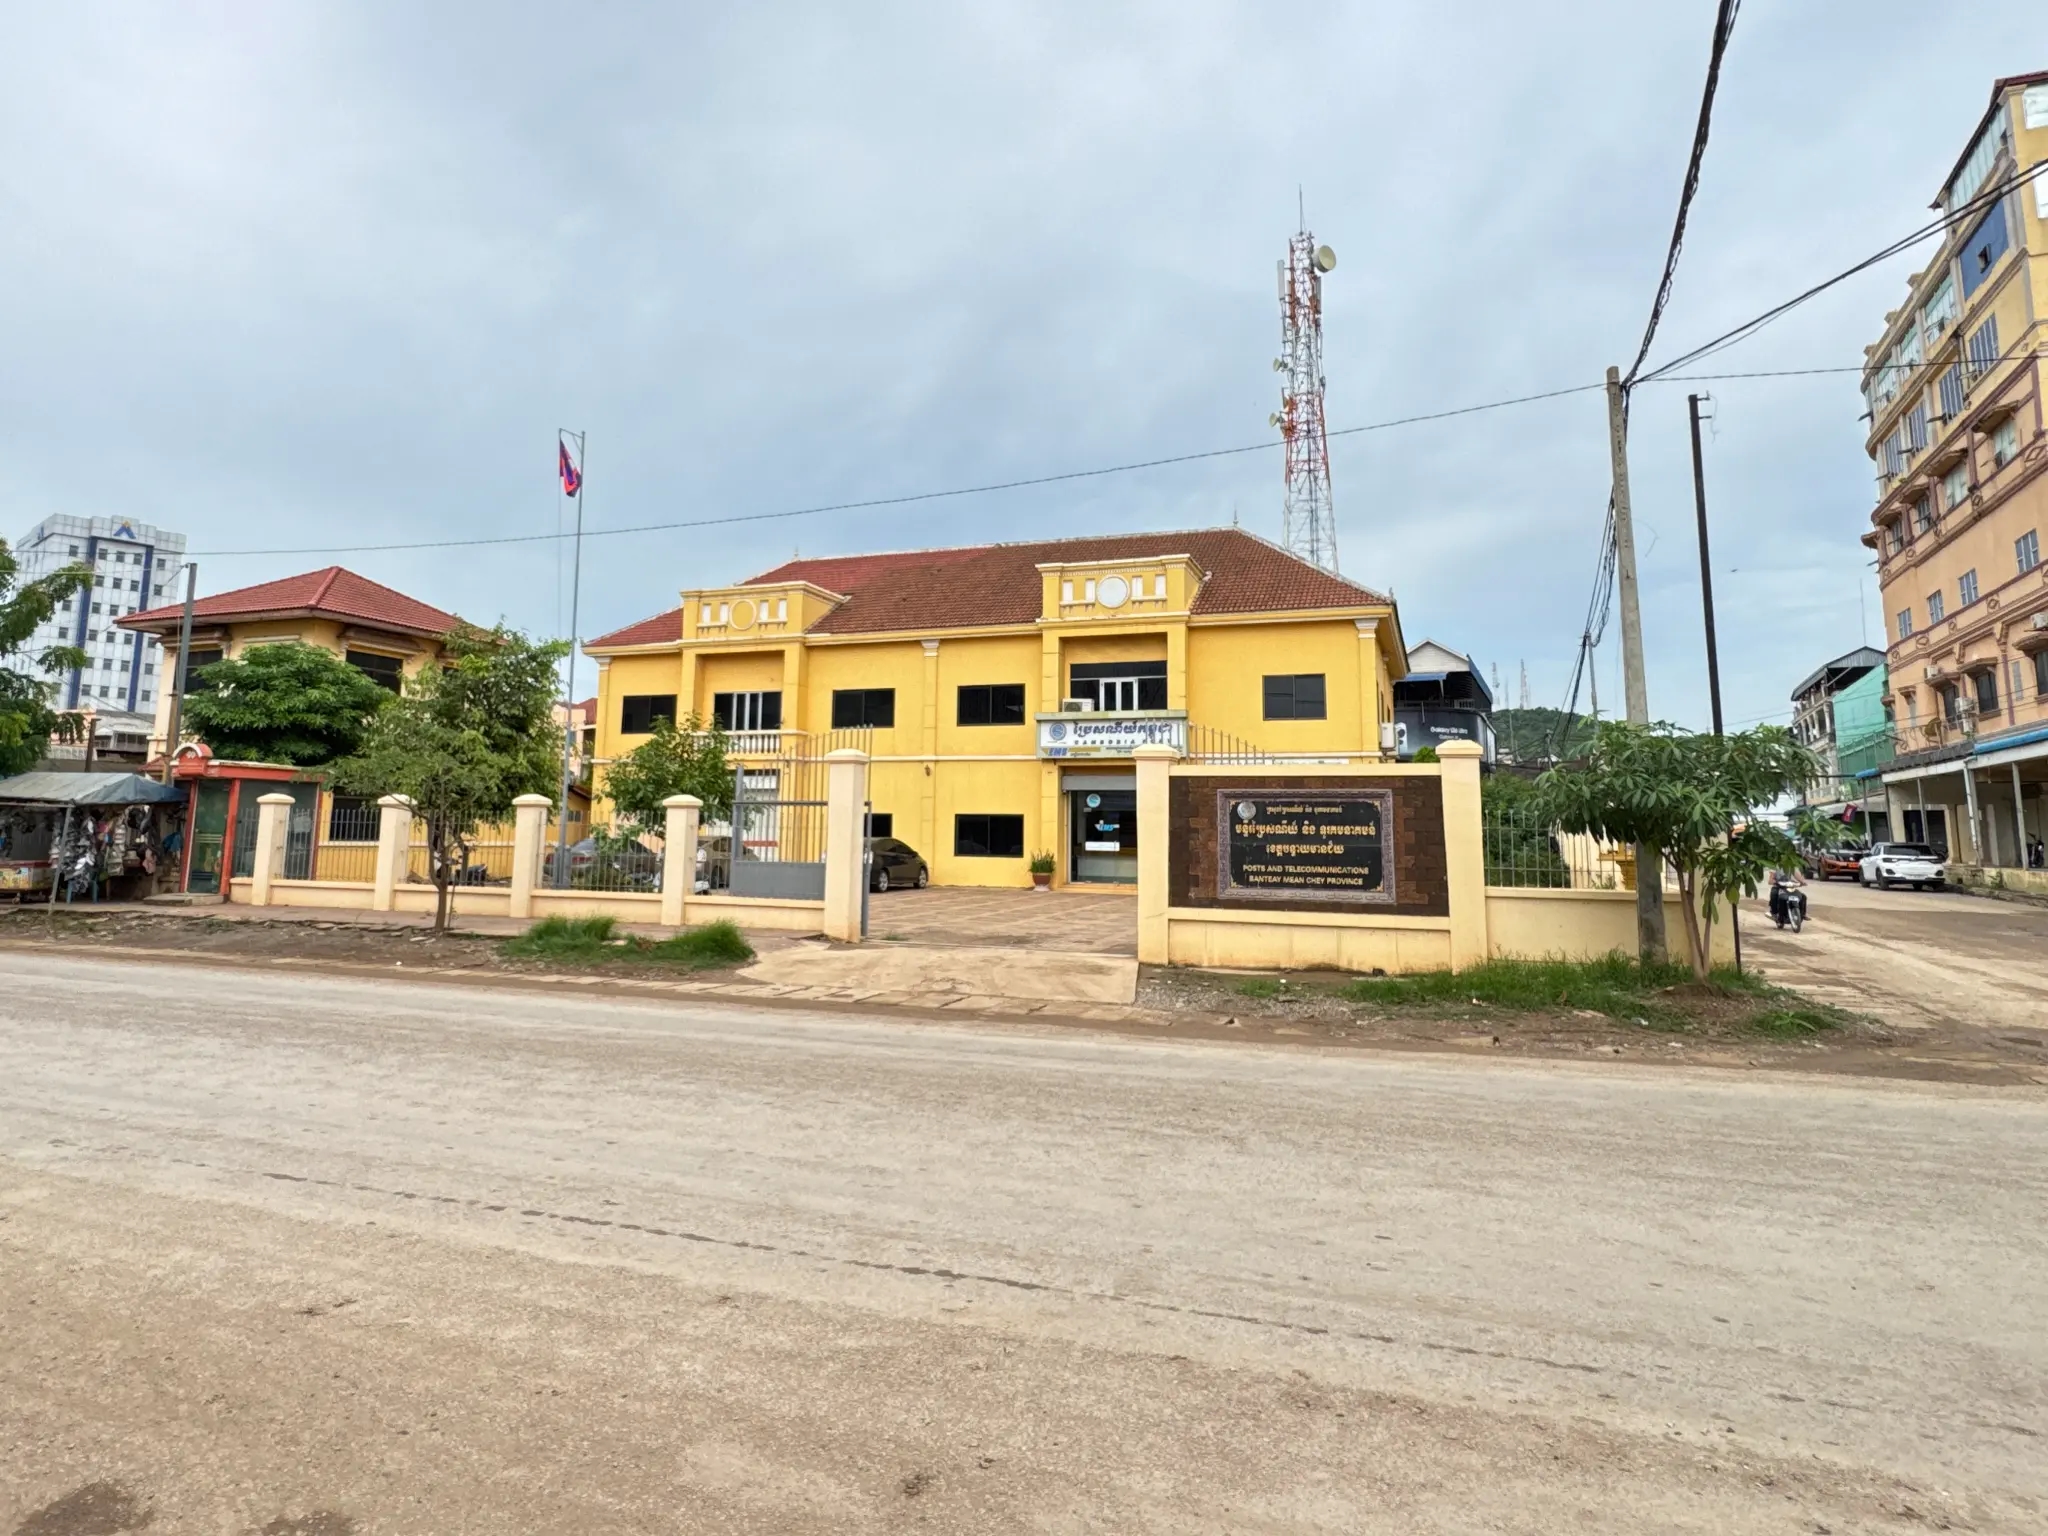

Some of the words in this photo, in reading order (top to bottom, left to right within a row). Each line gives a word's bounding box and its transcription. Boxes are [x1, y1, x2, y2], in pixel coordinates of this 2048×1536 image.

[1302, 820, 1316, 835] និង
[1243, 864, 1265, 872] POSTS
[1266, 865, 1283, 873] AND
[1285, 865, 1369, 875] TELECOMMUNICATIONS
[1249, 875, 1281, 883] BANTEAY
[1283, 876, 1304, 884] MEAN
[1306, 876, 1324, 884] CHEY
[1326, 877, 1363, 885] PROVINCE
